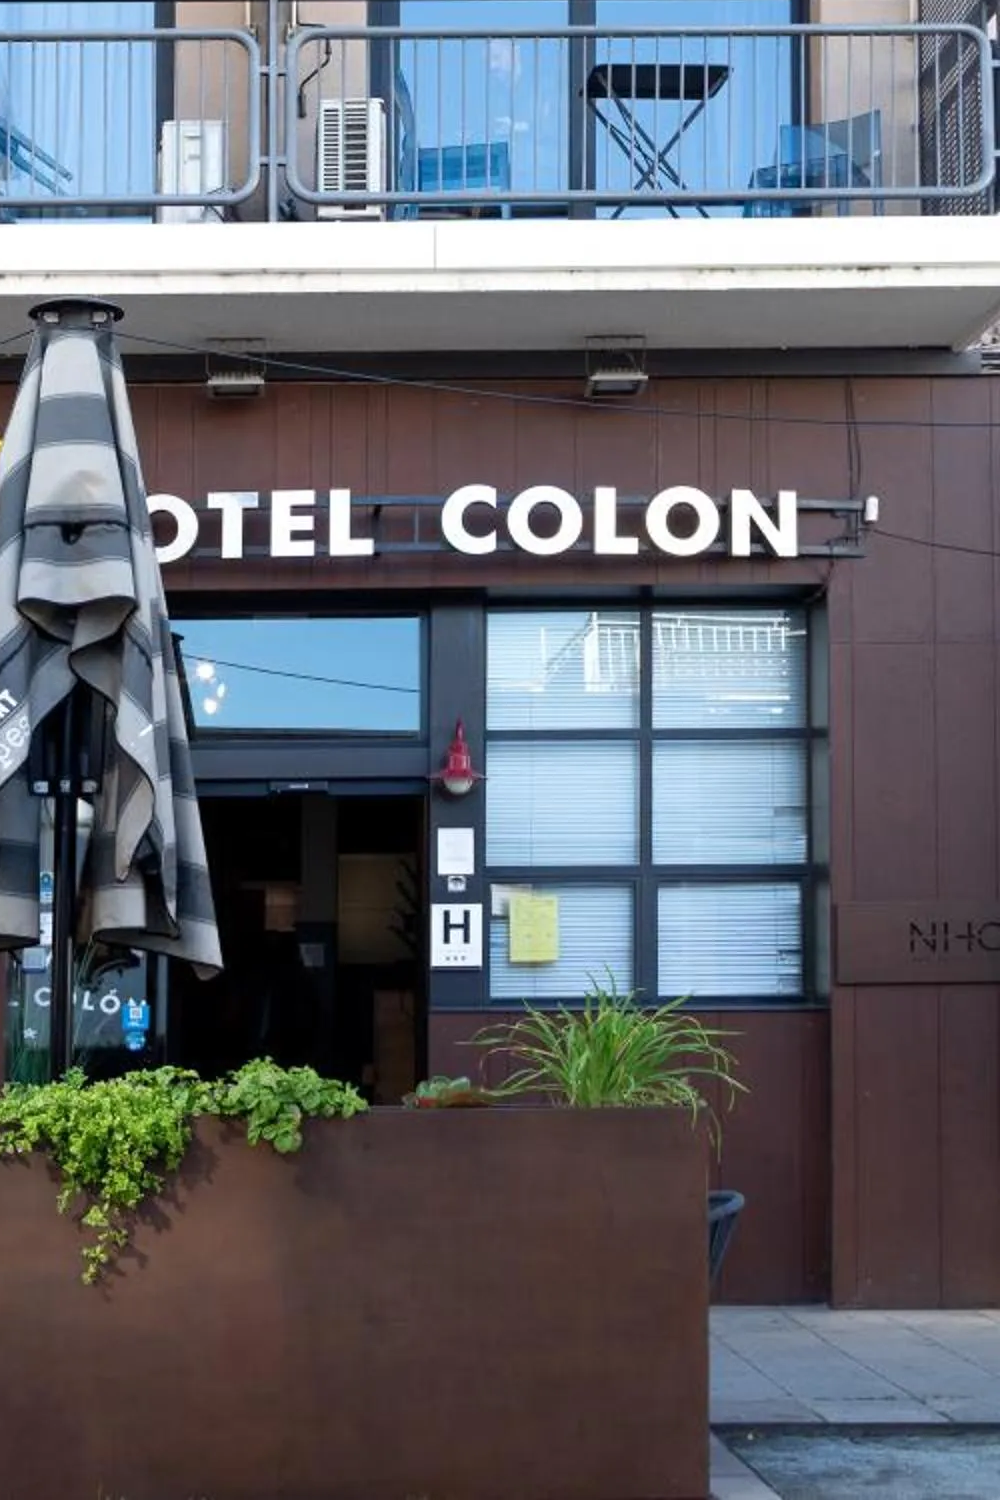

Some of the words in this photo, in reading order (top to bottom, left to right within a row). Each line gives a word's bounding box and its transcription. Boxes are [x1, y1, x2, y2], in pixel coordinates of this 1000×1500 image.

[145, 489, 375, 564] OTEL
[441, 485, 799, 557] COLON
[443, 909, 470, 944] H
[34, 987, 147, 1014] CLÓ
